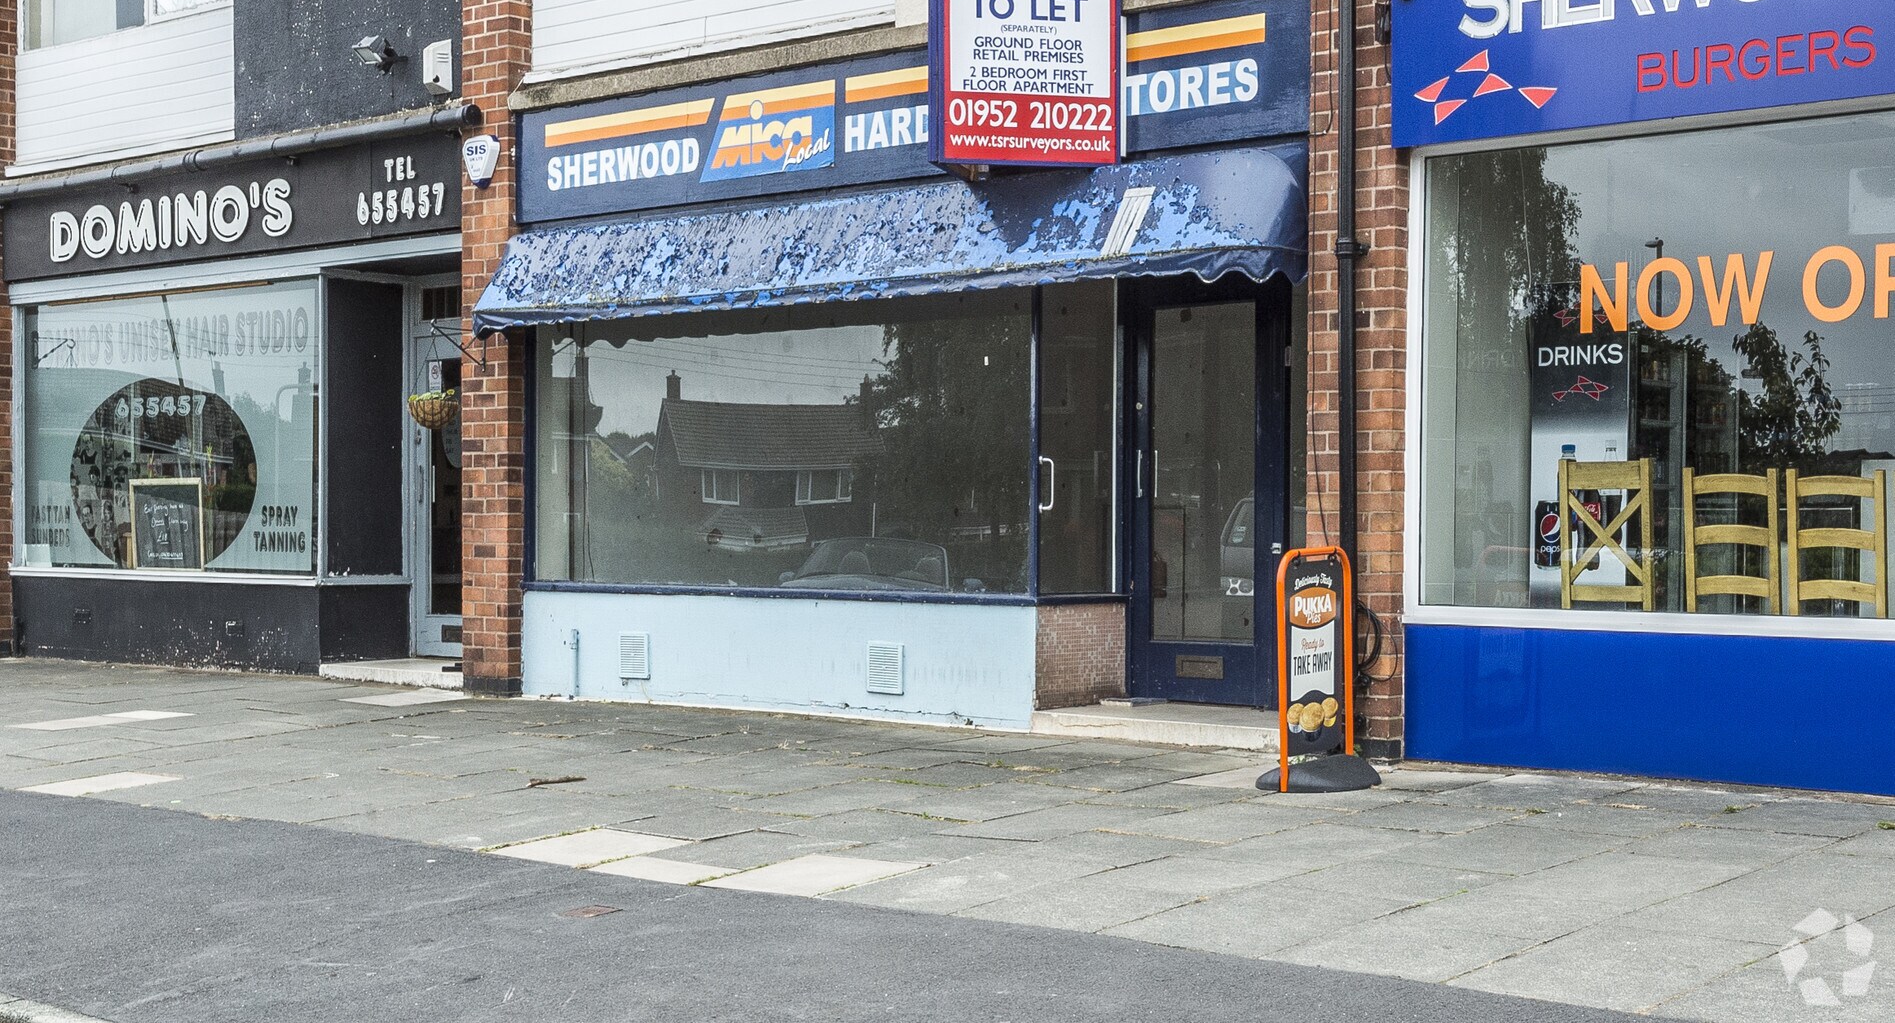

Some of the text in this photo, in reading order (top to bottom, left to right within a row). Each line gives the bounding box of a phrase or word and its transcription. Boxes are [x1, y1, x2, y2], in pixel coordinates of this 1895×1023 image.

[1000, 24, 1058, 35] (SEPARATELY)
[974, 36, 1082, 51] GROUND FLOOR
[973, 49, 1084, 63] RETAIL PREMISES
[1636, 25, 1877, 94] BURGERS
[970, 66, 1087, 81] 2 BEDROOM FIRST
[963, 79, 1094, 94] FLOOR APARTMENT
[547, 58, 1259, 191] SHERWOOD HARD TORES
[949, 99, 1112, 131] 01952 210222
[466, 145, 486, 156] SIS
[782, 127, 831, 171] Local
[950, 134, 1110, 153] www.tsrsurveyors.co.uk
[384, 156, 416, 183] TEL
[357, 182, 445, 226] 655457
[50, 178, 292, 262] DOMINO'S
[1579, 250, 1774, 334] NOW
[186, 314, 229, 359] HAIR
[235, 306, 308, 356] STUDIO
[1538, 343, 1624, 367] DRINKS
[115, 395, 207, 418] 655457
[261, 505, 298, 527] SPRAY
[253, 531, 305, 553] TANNING
[1540, 545, 1560, 553] peps
[1294, 593, 1332, 617] PUKKA
[1306, 611, 1321, 624] Pies
[1301, 637, 1325, 654] Ready to
[1293, 651, 1332, 676] TAKE AWAY
